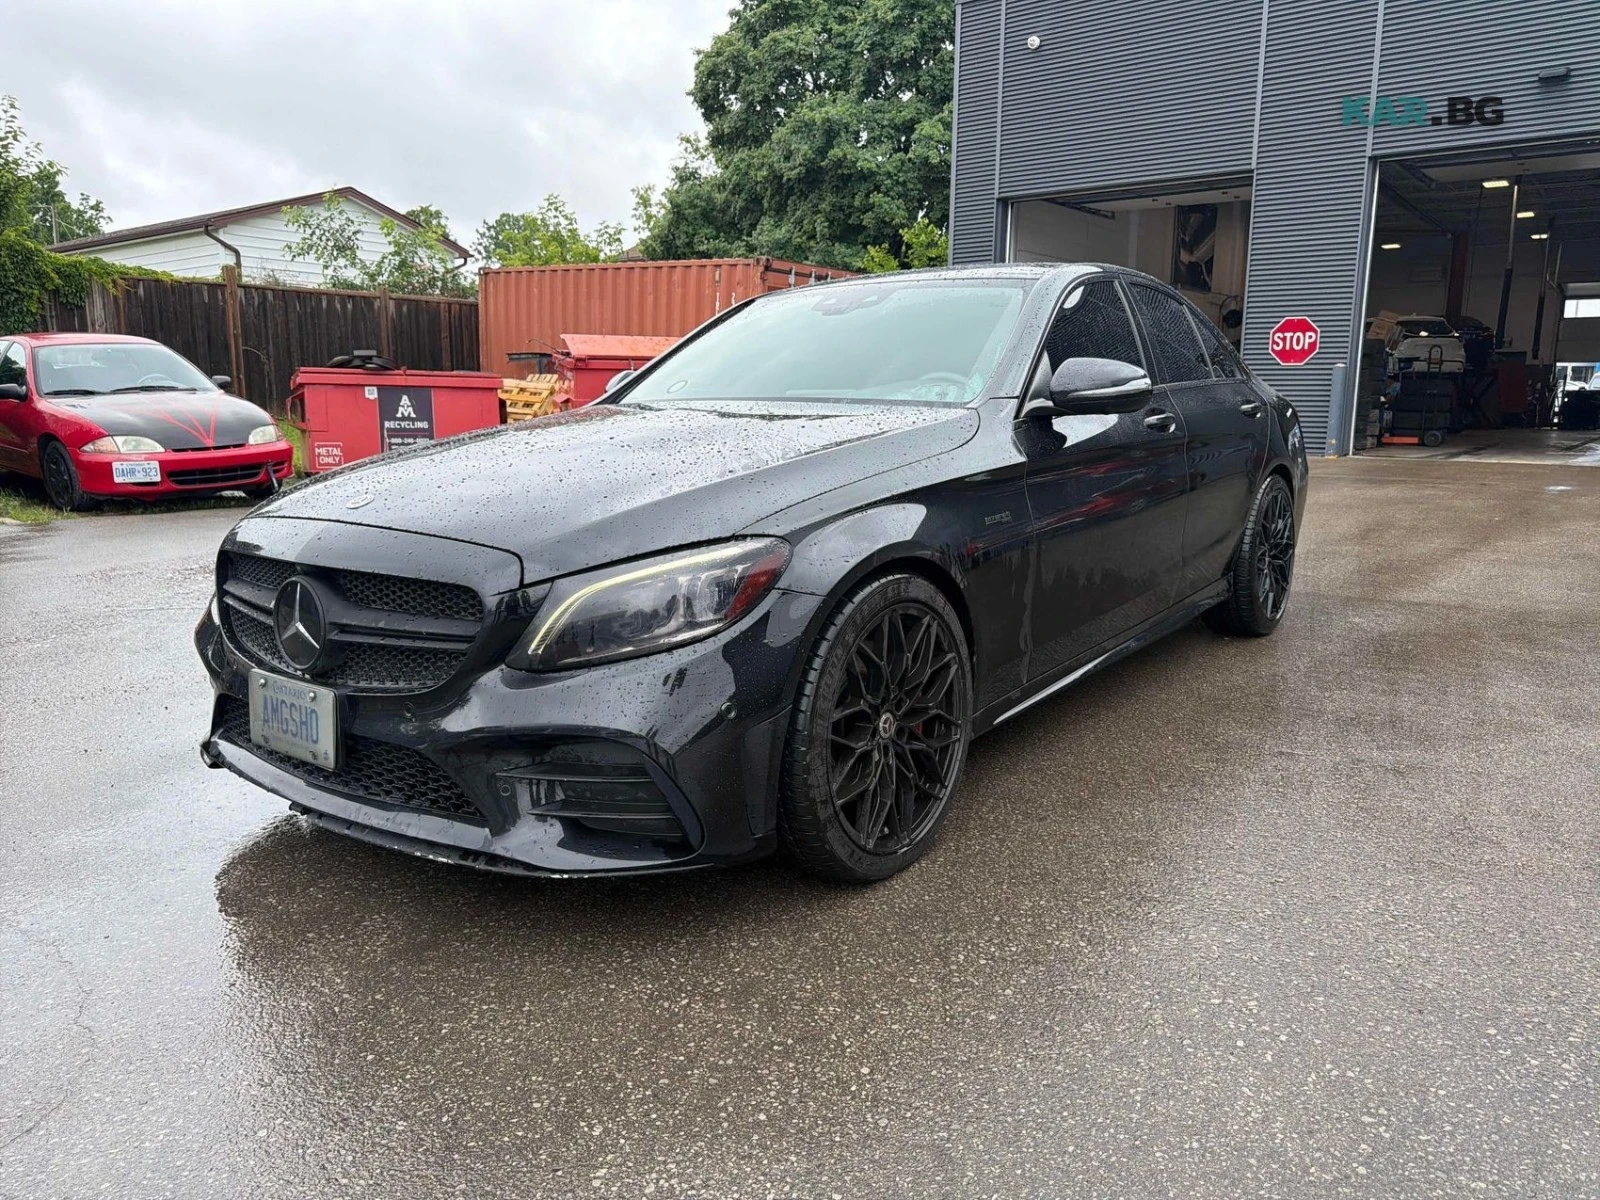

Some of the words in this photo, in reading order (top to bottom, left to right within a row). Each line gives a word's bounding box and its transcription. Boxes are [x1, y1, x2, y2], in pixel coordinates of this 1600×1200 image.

[1273, 332, 1316, 350] STOP
[319, 456, 340, 464] ONLY
[141, 467, 158, 477] 923
